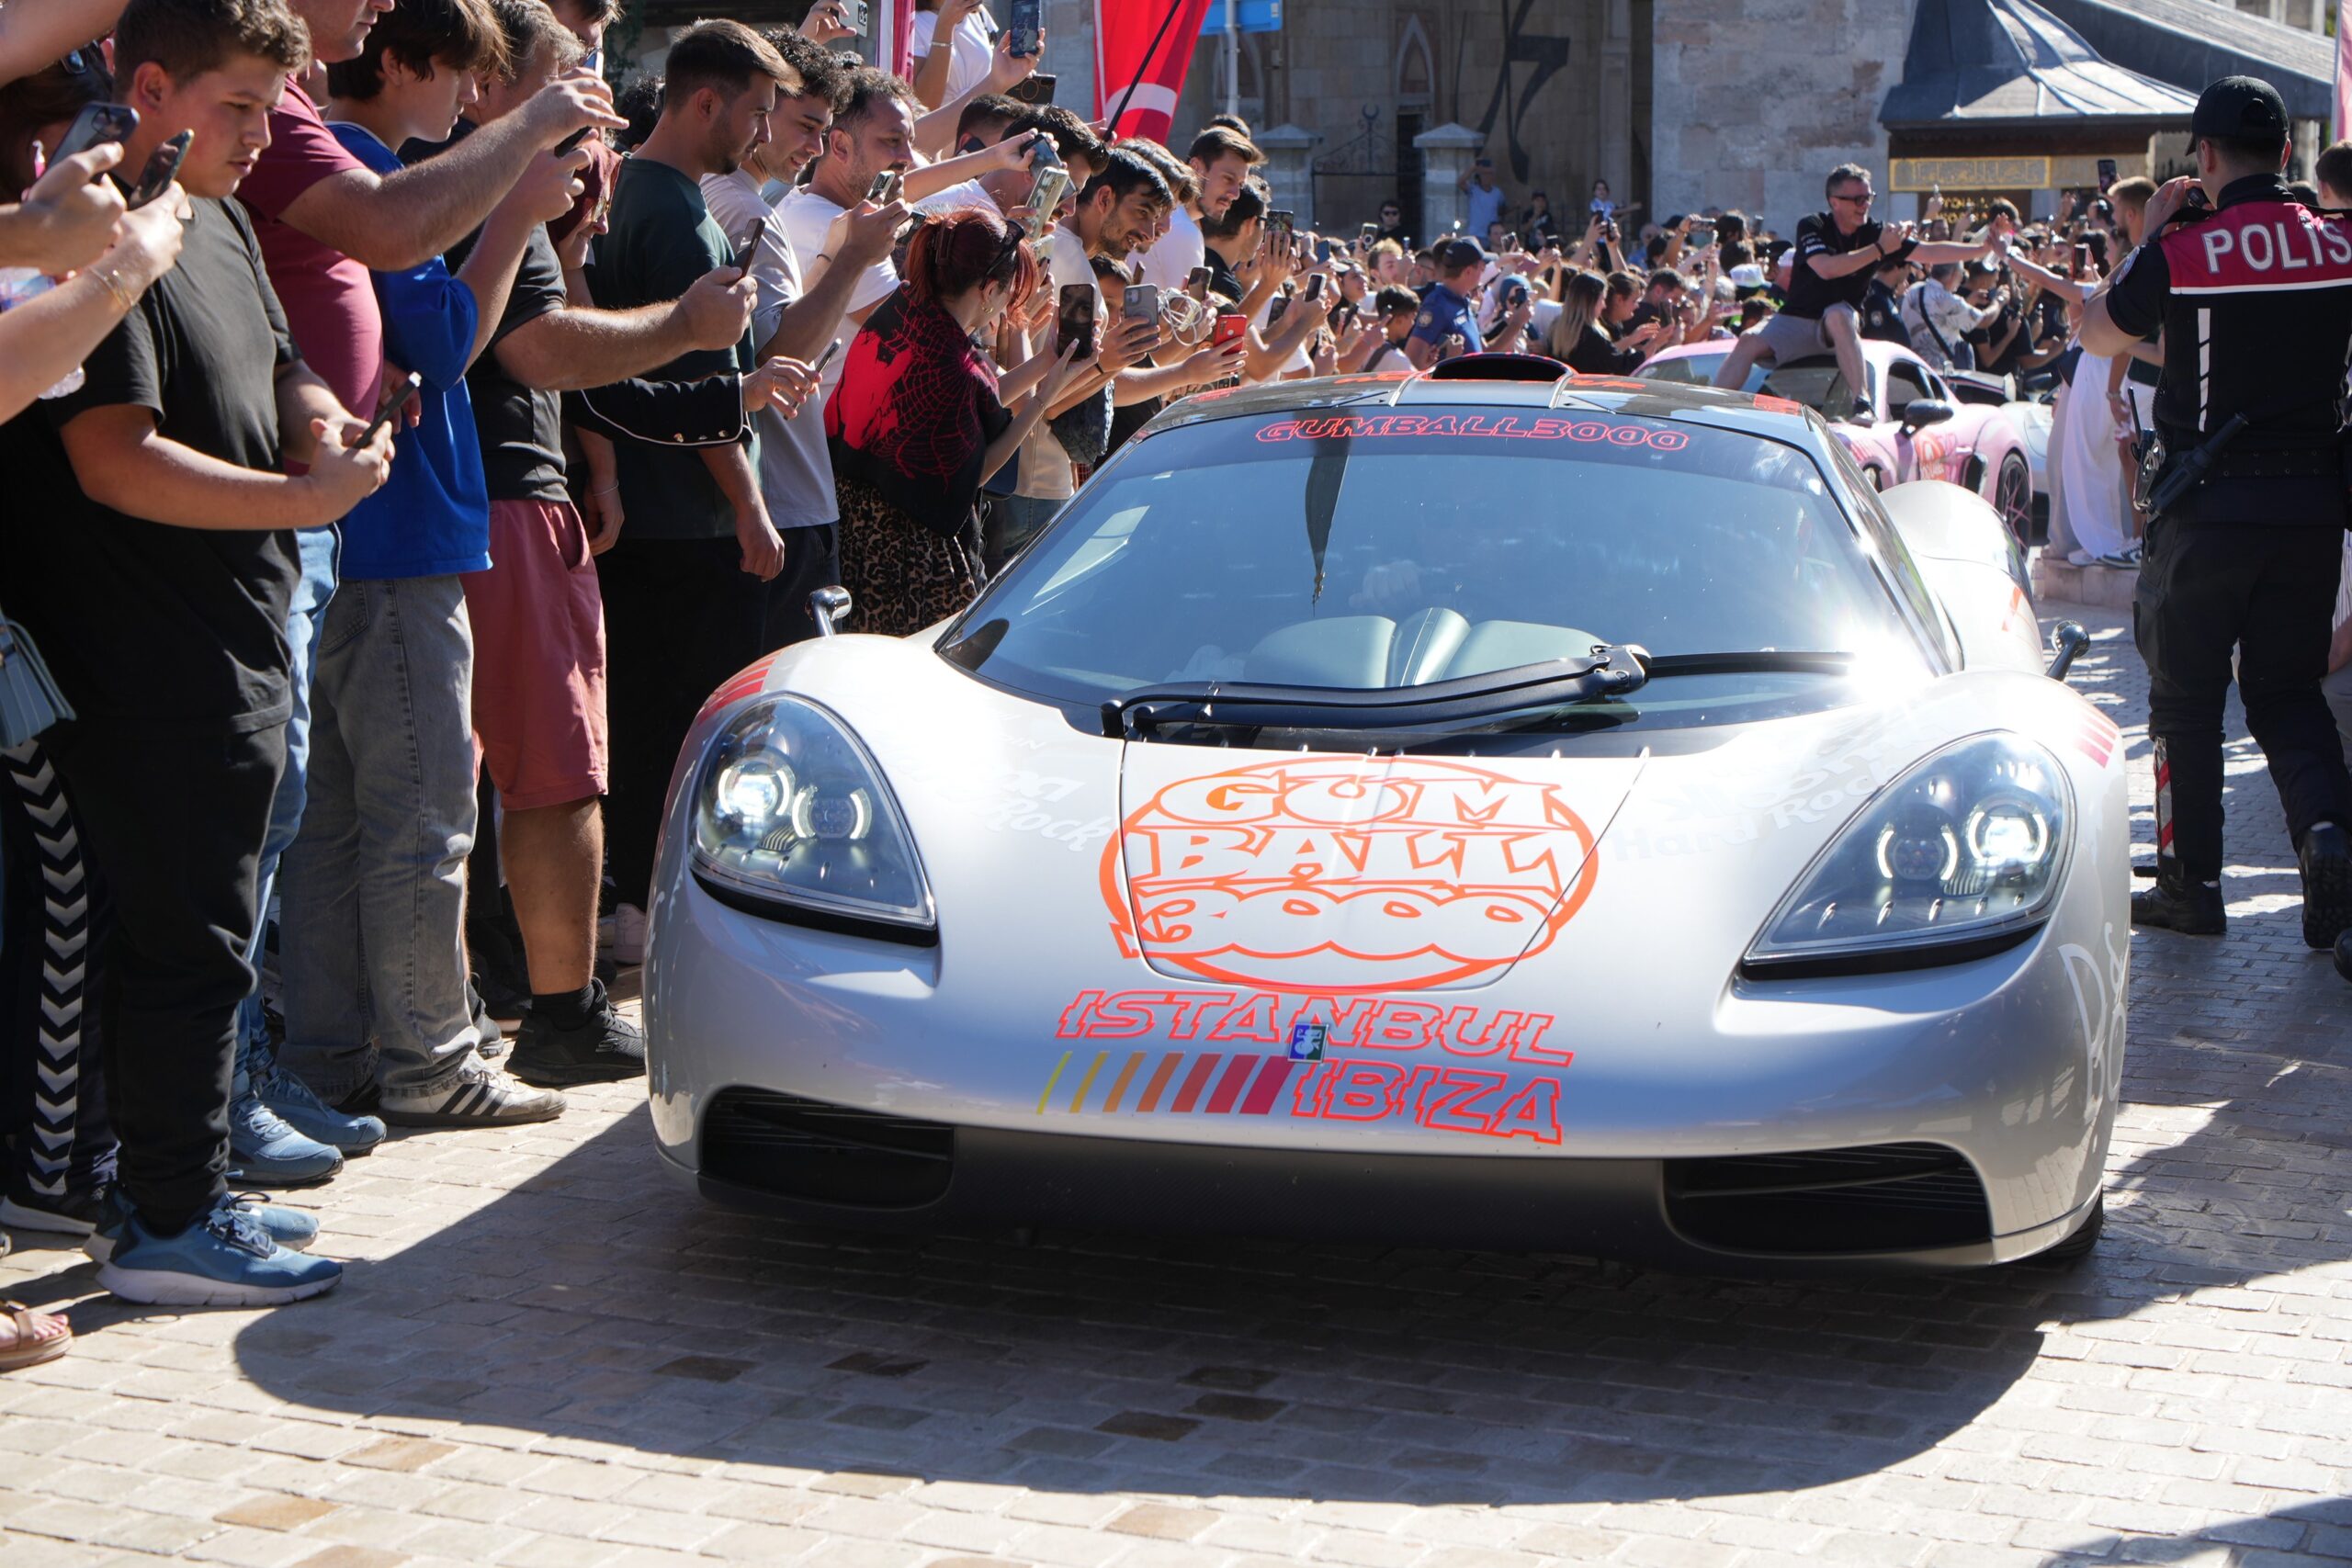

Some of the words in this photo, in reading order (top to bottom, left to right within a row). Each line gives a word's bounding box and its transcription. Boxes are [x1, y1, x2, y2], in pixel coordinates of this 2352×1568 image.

[1255, 415, 1690, 451] GUMBALL3000
[1152, 770, 1566, 830] GUM
[1125, 825, 1567, 906] BALL
[1109, 883, 1558, 963] 3000
[1054, 989, 1575, 1067] ISTANBUL
[1290, 1057, 1563, 1146] IBIZA
